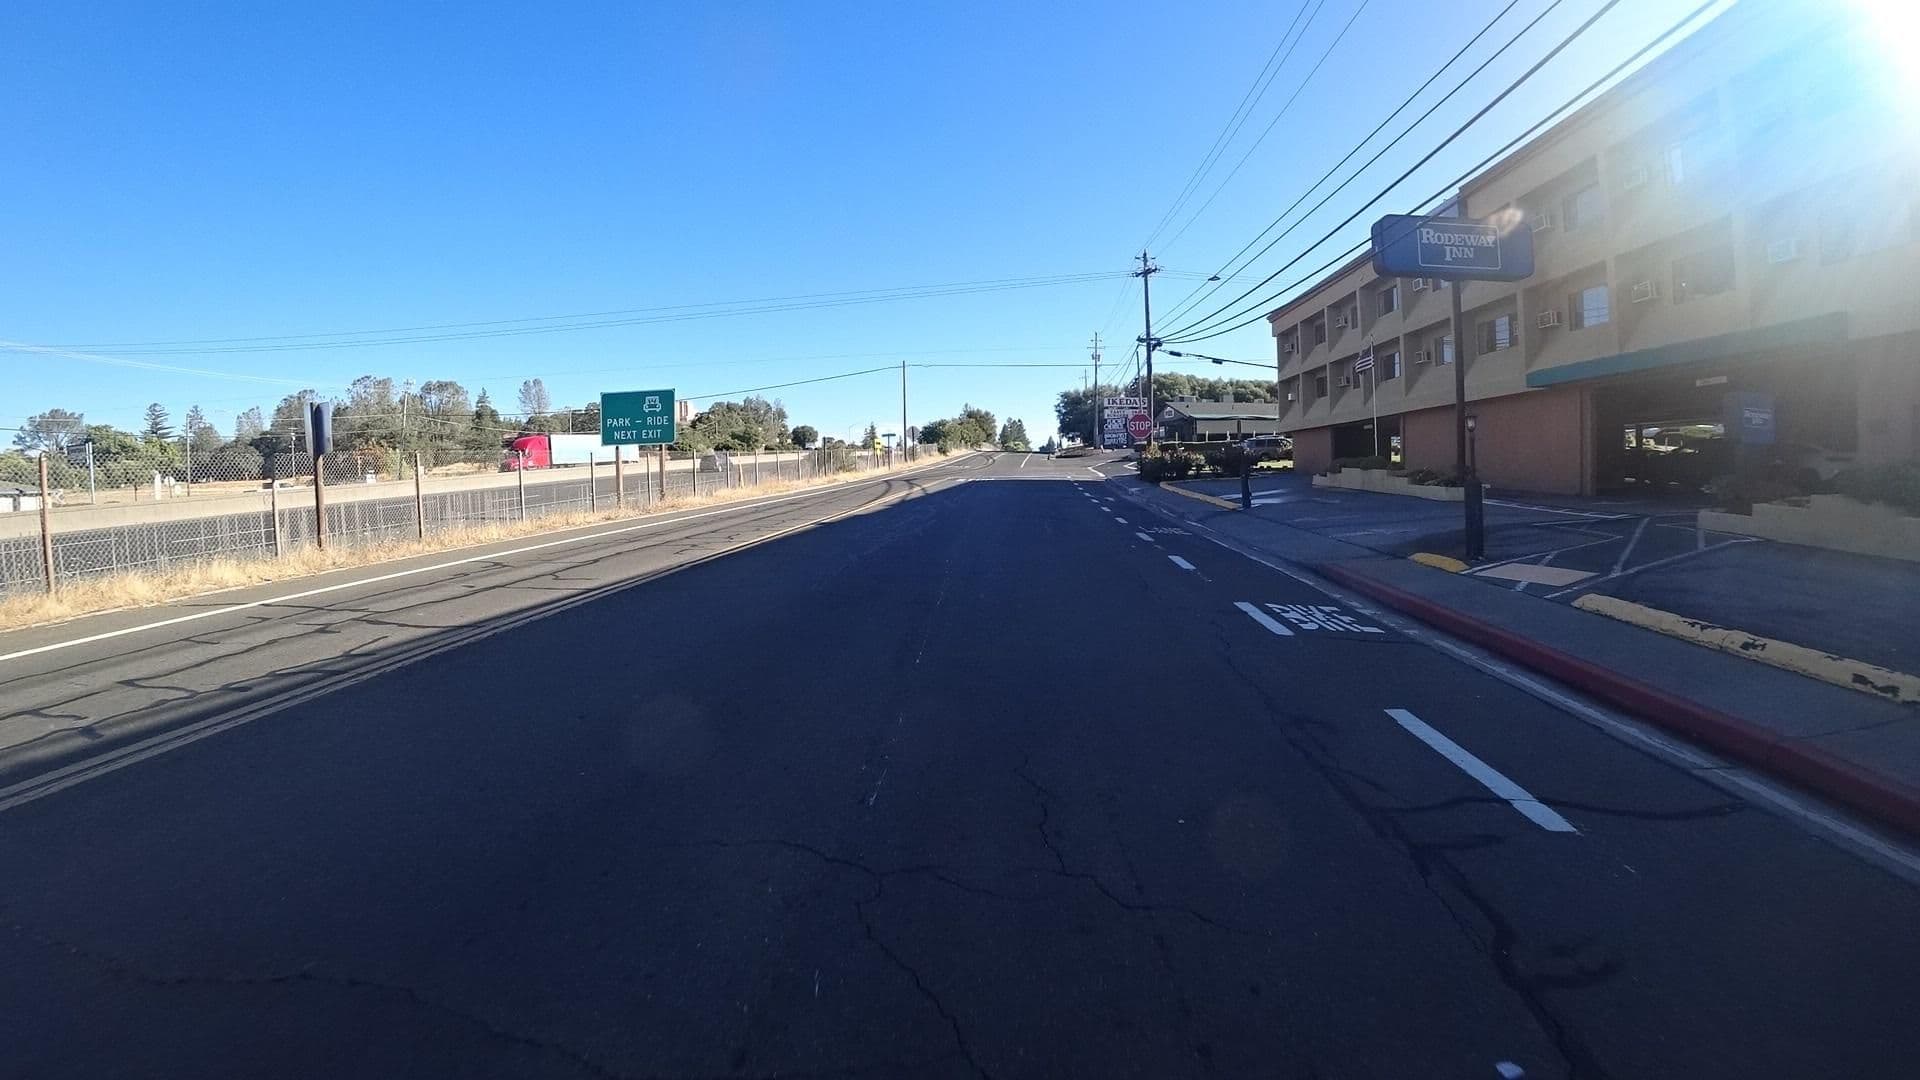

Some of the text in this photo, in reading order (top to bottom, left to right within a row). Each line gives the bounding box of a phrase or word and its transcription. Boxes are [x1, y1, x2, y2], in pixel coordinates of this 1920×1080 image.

[1421, 228, 1497, 247] RODEWAY
[1444, 246, 1474, 261] INN
[606, 417, 631, 428] PARK
[646, 416, 669, 426] RIDE
[1129, 421, 1151, 431] STOP
[614, 429, 662, 440] NEXT EXIT
